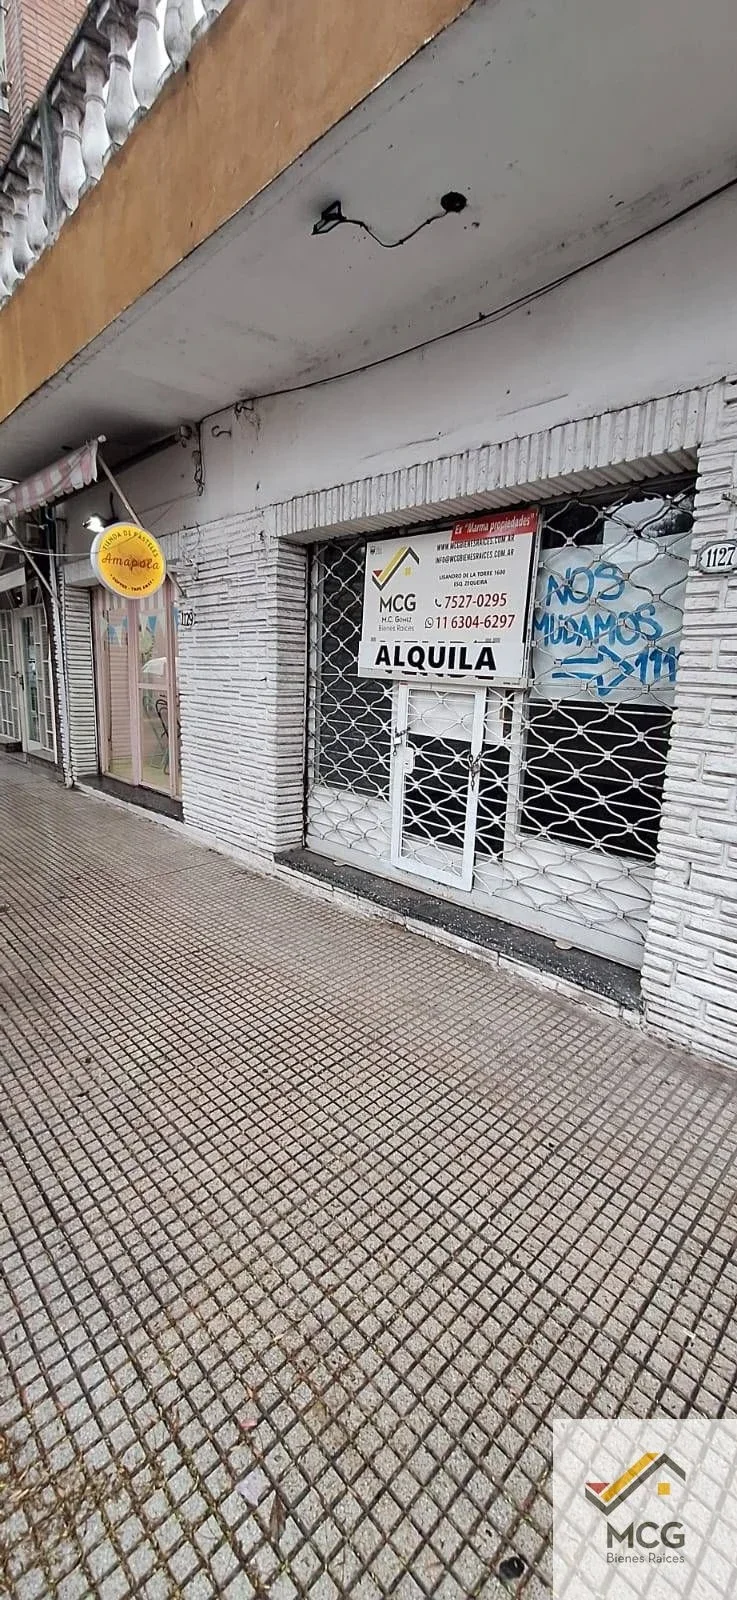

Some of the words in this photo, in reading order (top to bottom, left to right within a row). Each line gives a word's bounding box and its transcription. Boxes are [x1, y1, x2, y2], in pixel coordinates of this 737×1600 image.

[102, 533, 121, 551] TIENDA
[133, 531, 159, 558] PASTELES
[101, 552, 160, 575] Amapola
[706, 546, 736, 567] 1127
[546, 566, 625, 607] NOS
[379, 593, 417, 613] MCG
[444, 593, 508, 609] 7527-0295
[435, 617, 447, 629] 11
[451, 614, 516, 629] 6304-6297
[534, 603, 664, 647] MUDAMOS
[375, 645, 497, 671] ALQUILA
